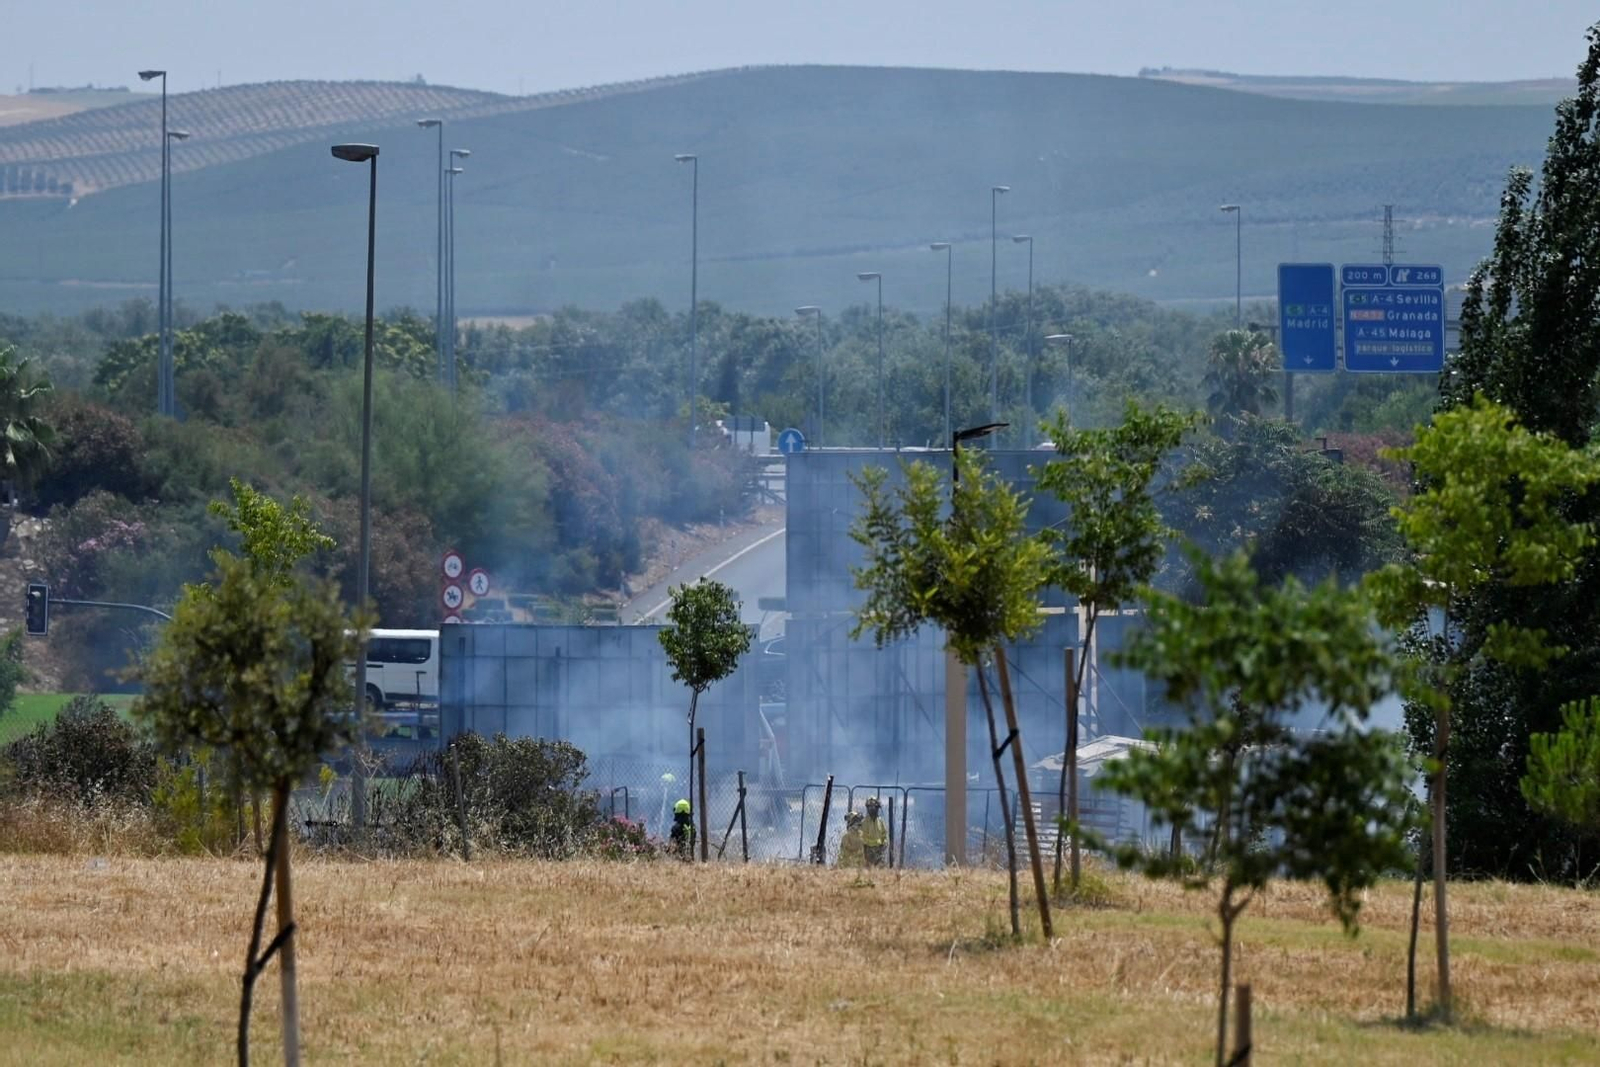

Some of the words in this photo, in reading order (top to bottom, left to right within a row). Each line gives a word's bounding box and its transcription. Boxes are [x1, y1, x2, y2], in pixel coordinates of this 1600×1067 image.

[1348, 271, 1368, 279] 200
[1416, 271, 1437, 280] 268
[1349, 294, 1367, 304] E-5
[1372, 294, 1393, 304] A-4
[1396, 294, 1438, 304] Sevilla
[1309, 305, 1328, 314] A-4
[1387, 310, 1438, 321] Granada
[1287, 318, 1328, 328] Madrid
[1358, 327, 1386, 337] A-45
[1356, 344, 1388, 355] parque
